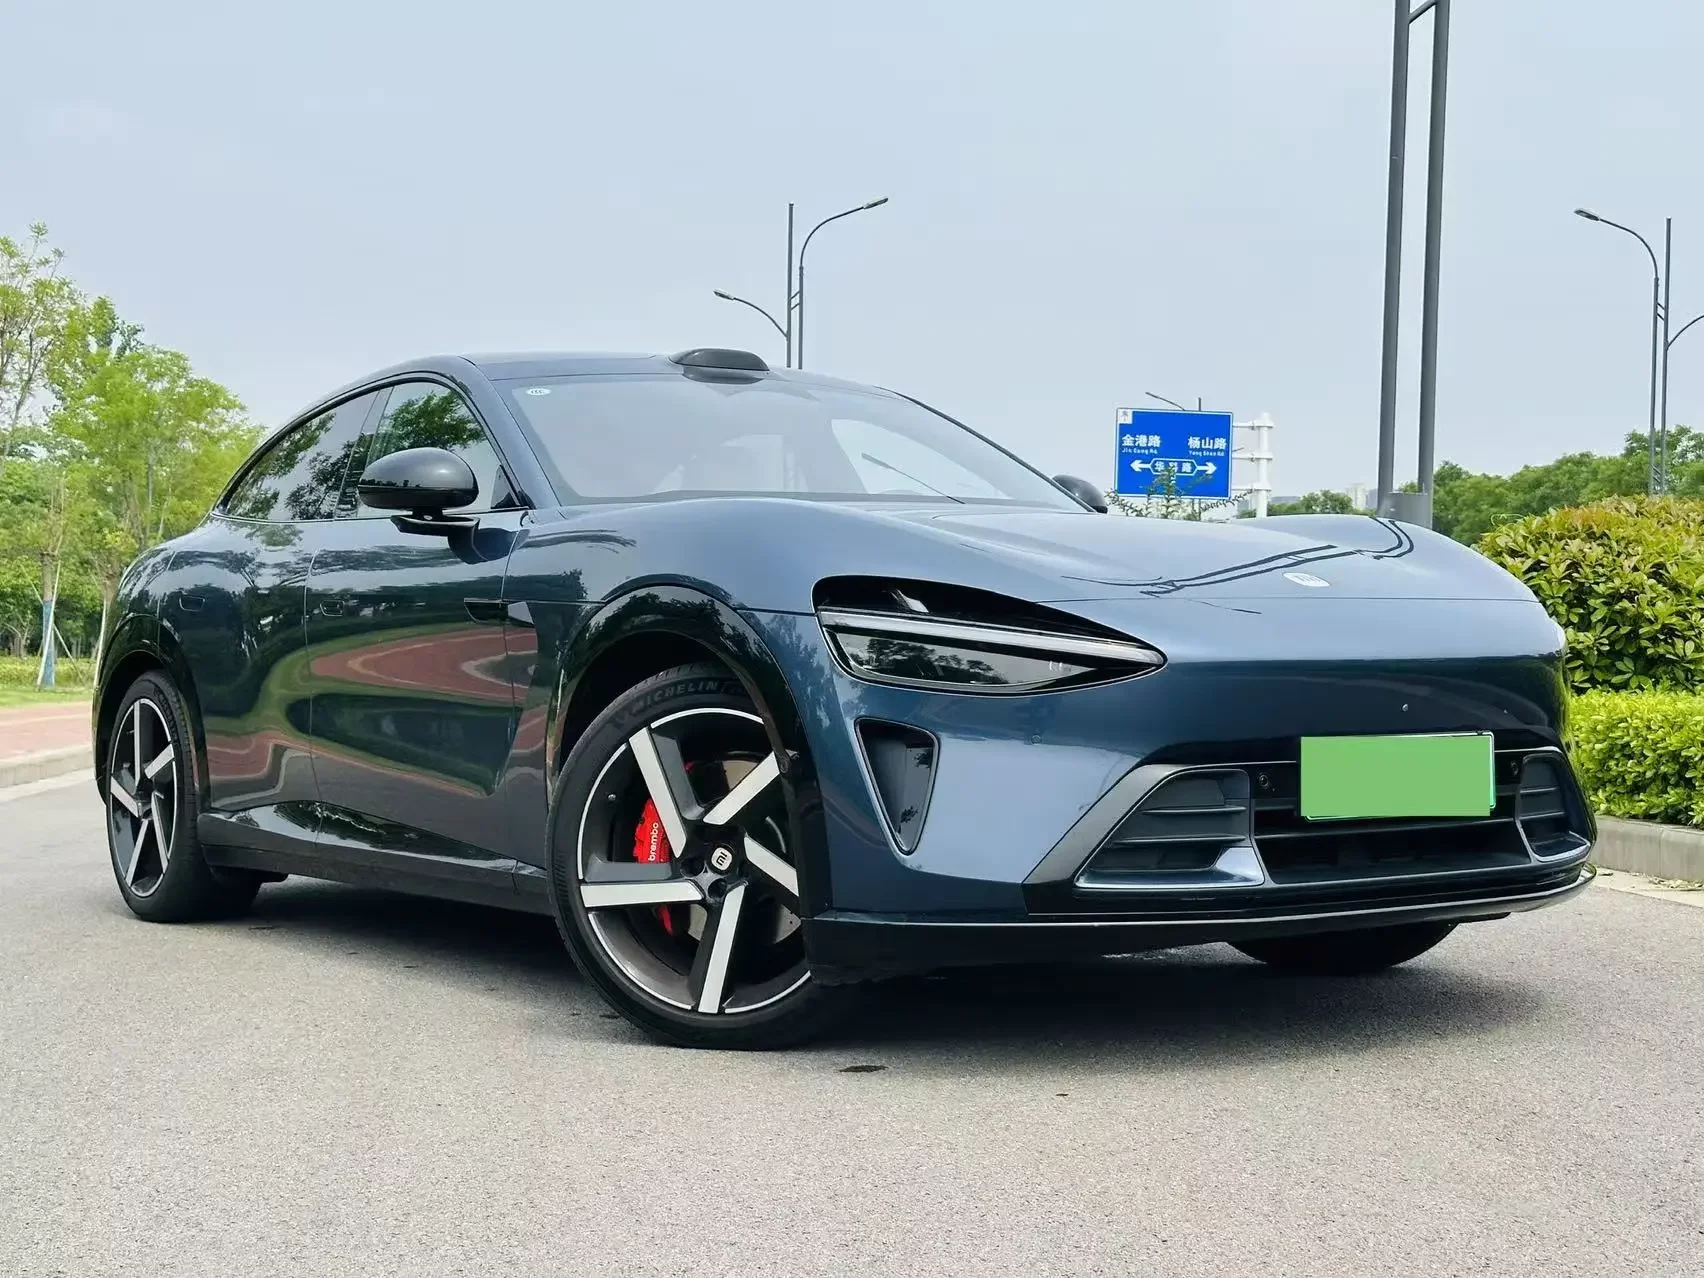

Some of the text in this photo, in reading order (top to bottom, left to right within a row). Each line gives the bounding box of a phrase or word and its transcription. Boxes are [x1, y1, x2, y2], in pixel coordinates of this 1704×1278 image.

[1121, 434, 1161, 447] 金港路
[1187, 436, 1227, 449] 杨山路
[647, 822, 659, 862] brembo
